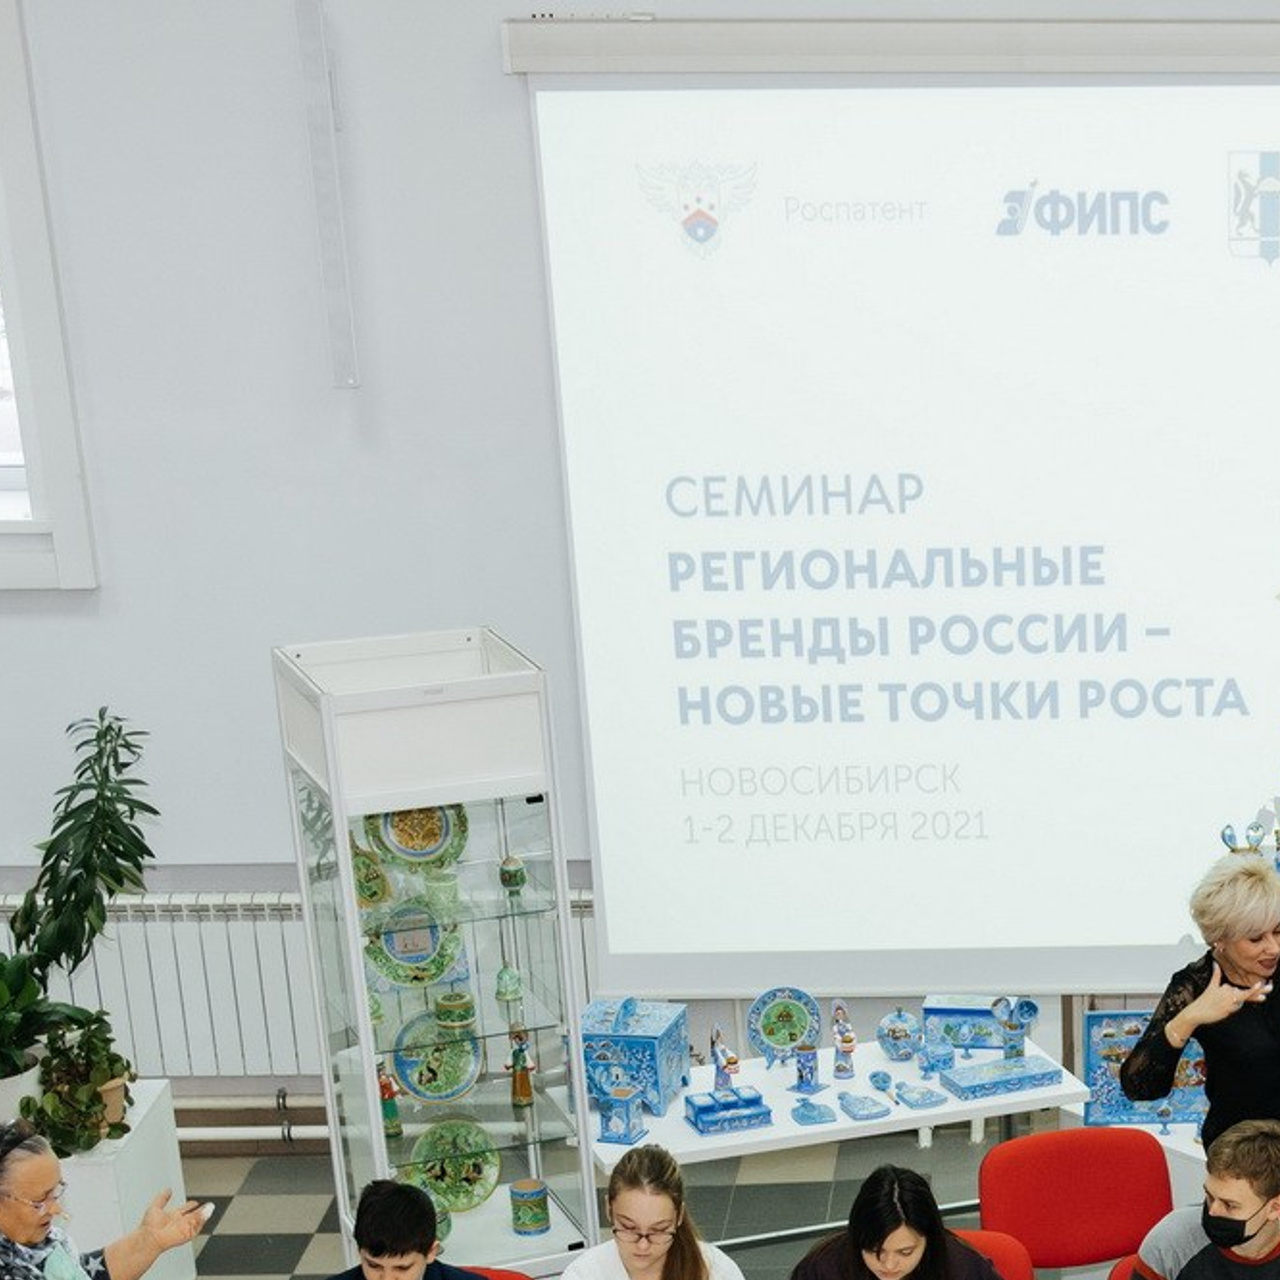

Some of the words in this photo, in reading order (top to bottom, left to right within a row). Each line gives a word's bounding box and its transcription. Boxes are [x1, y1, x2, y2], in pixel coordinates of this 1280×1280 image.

[784, 196, 928, 224] Роспатент
[1034, 188, 1171, 236] ФИПС
[665, 472, 924, 519] СЕМИНАР
[667, 545, 1106, 592] РЕГИОНАЛЬНЫЕ
[673, 616, 890, 665] БРЕНДЫ
[908, 612, 1129, 657] РОССИИ
[678, 682, 866, 726] НОВЫЕ
[877, 679, 1061, 724] ТОЧКИ
[1078, 676, 1251, 720] РОСТА
[680, 763, 962, 797] НОВОСИБИРСК
[684, 813, 736, 844] 1-2
[745, 811, 900, 849] ДЕКАБРЯ
[909, 809, 991, 842] 2021
